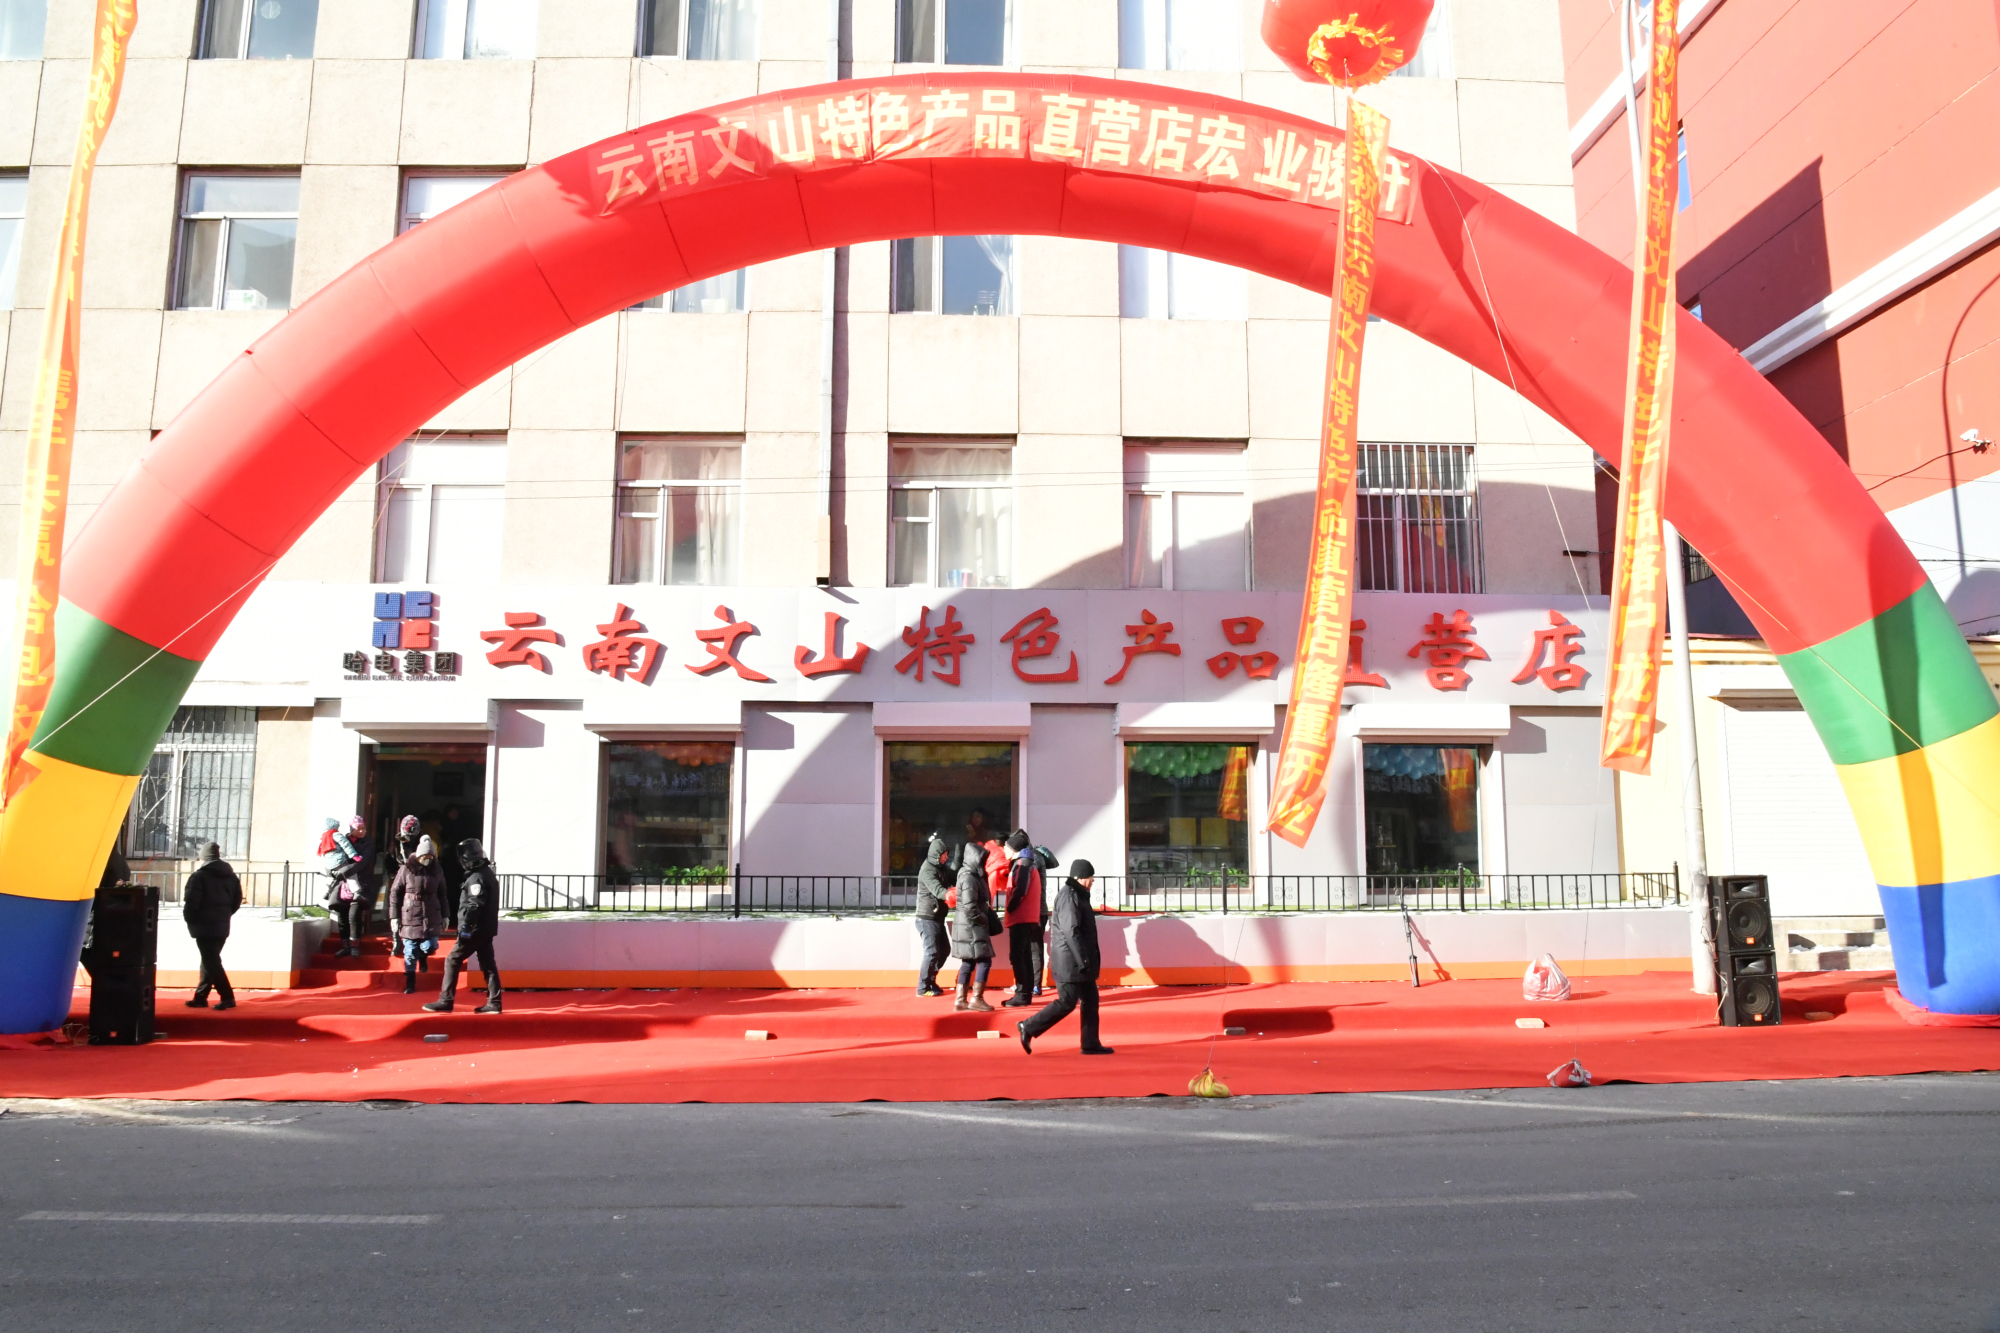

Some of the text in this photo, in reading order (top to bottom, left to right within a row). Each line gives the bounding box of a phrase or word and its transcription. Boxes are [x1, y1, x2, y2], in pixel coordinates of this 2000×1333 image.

[342, 650, 460, 674] 哈电集团
[406, 674, 456, 682] CORPORATION
